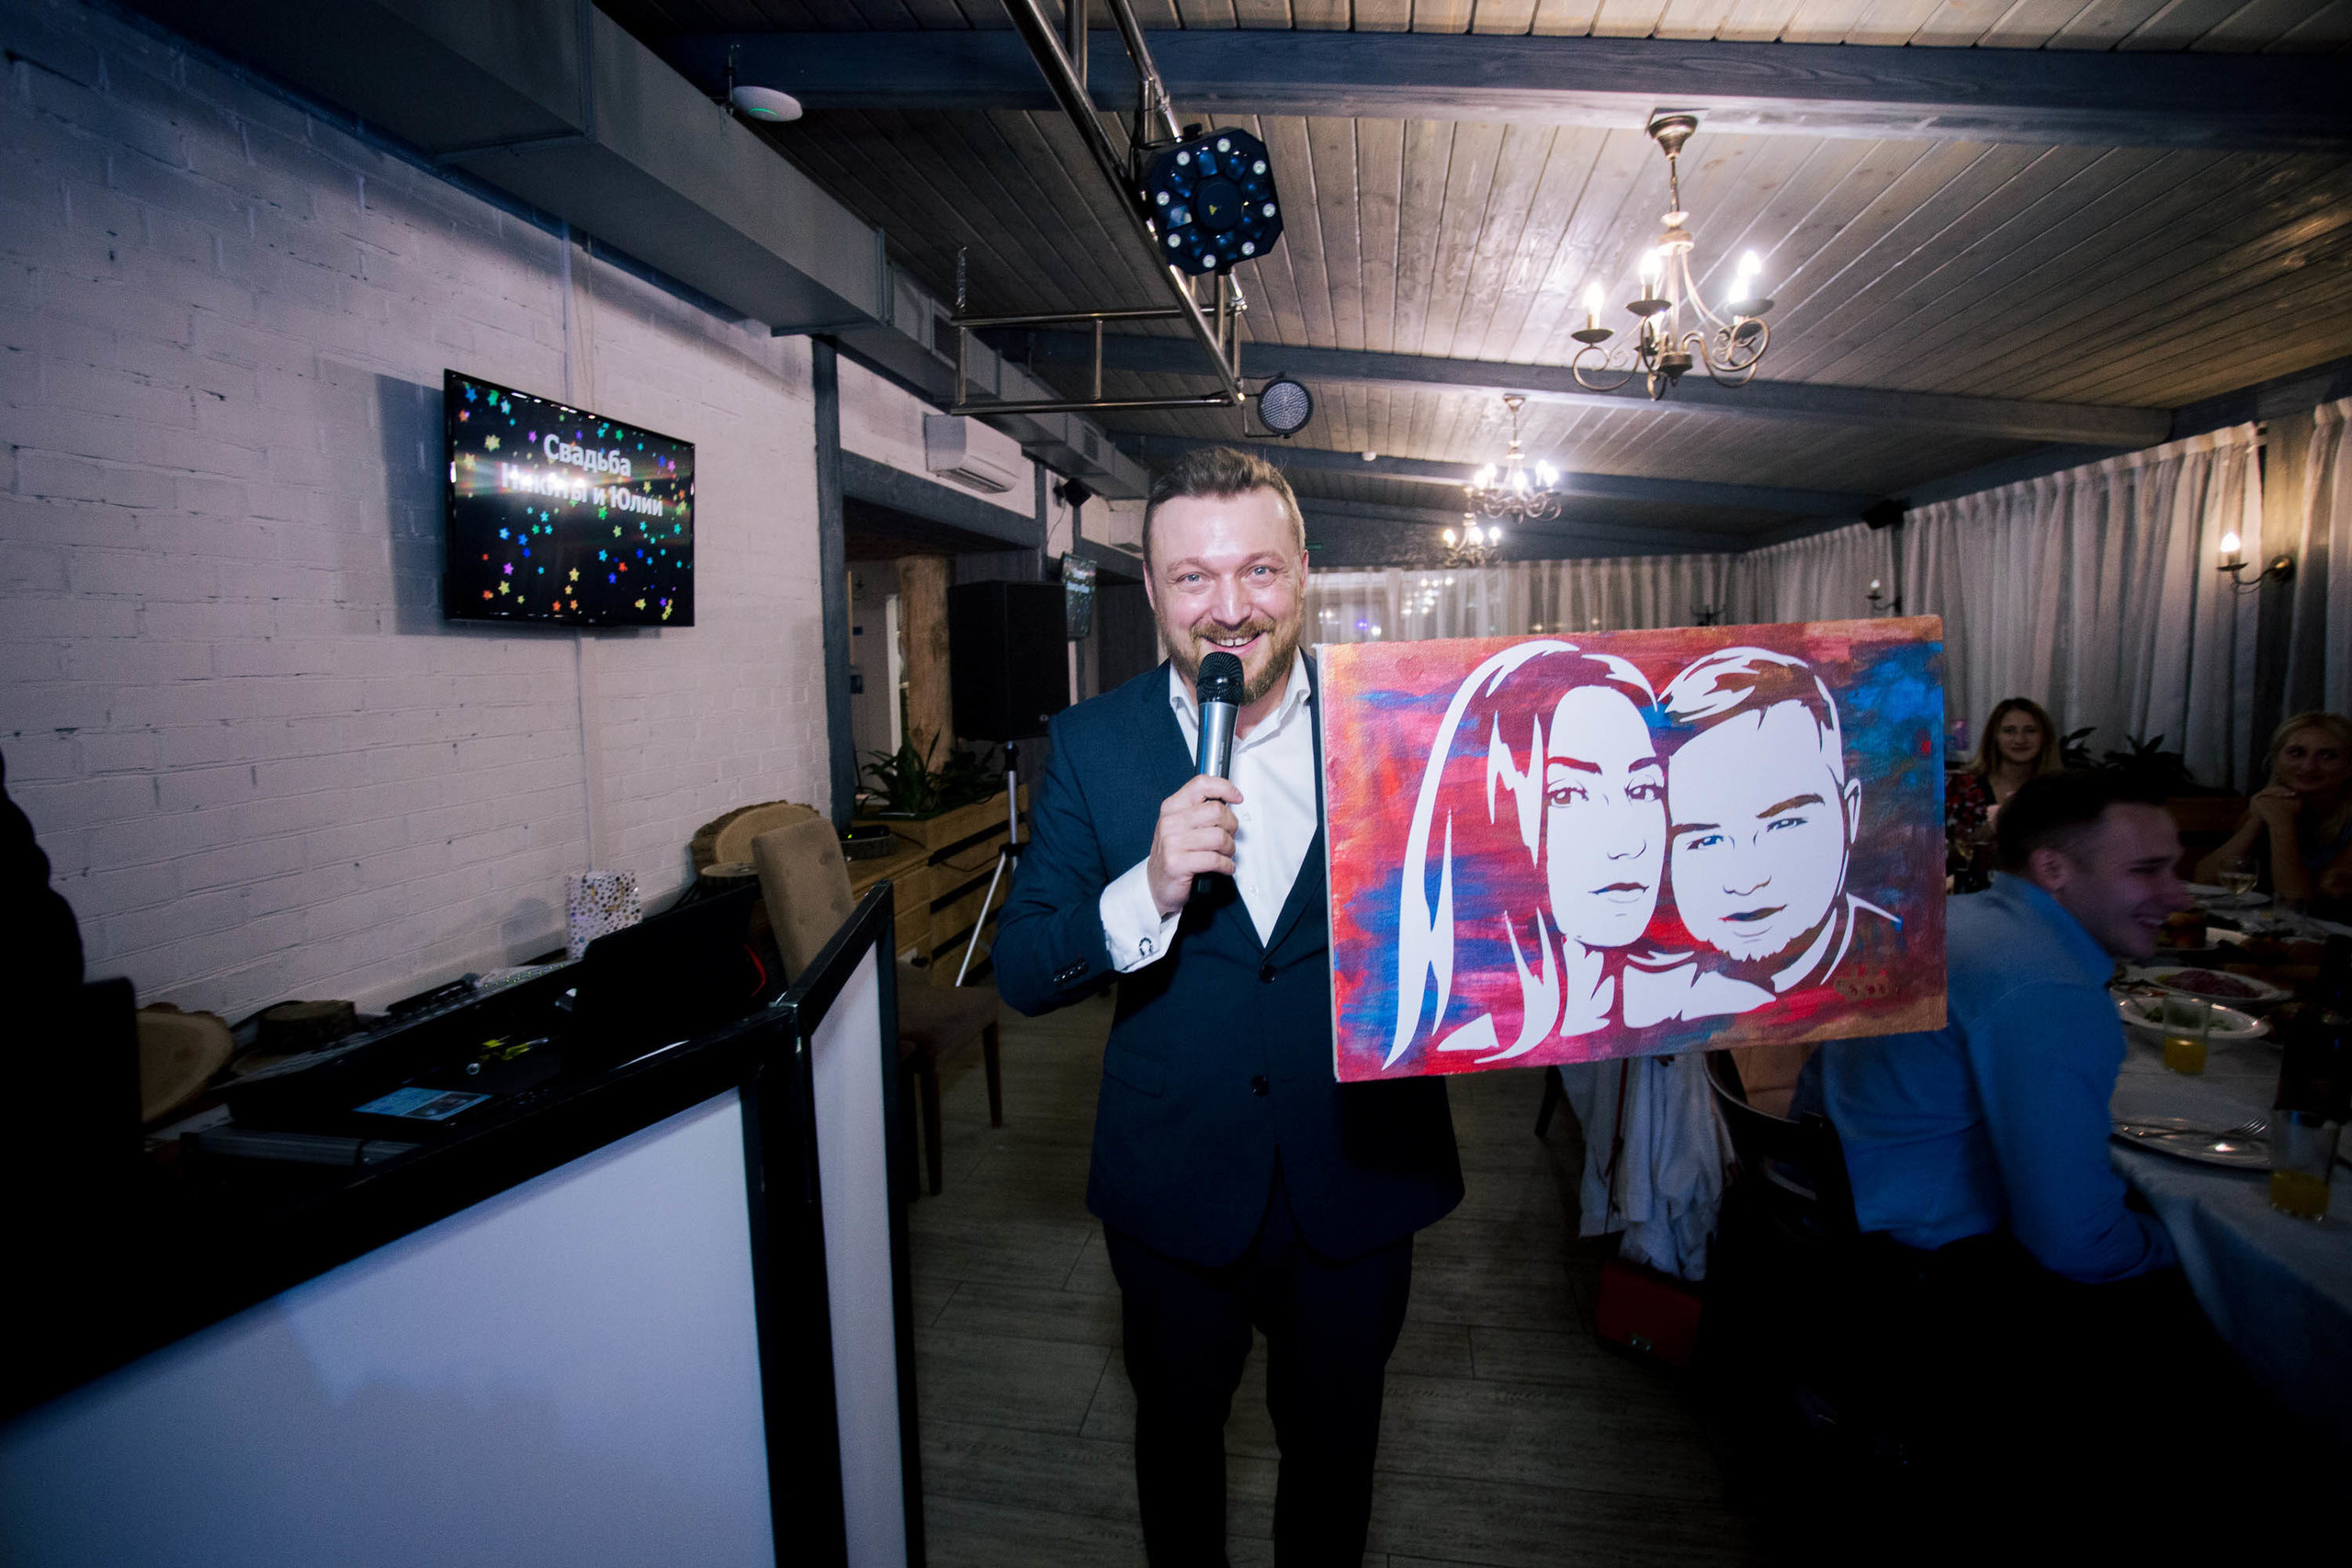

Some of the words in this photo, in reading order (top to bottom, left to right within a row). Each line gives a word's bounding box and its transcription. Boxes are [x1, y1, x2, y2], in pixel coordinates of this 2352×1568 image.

[544, 434, 631, 477] Свадьба
[593, 487, 605, 506] и
[610, 485, 663, 517] Юлии
